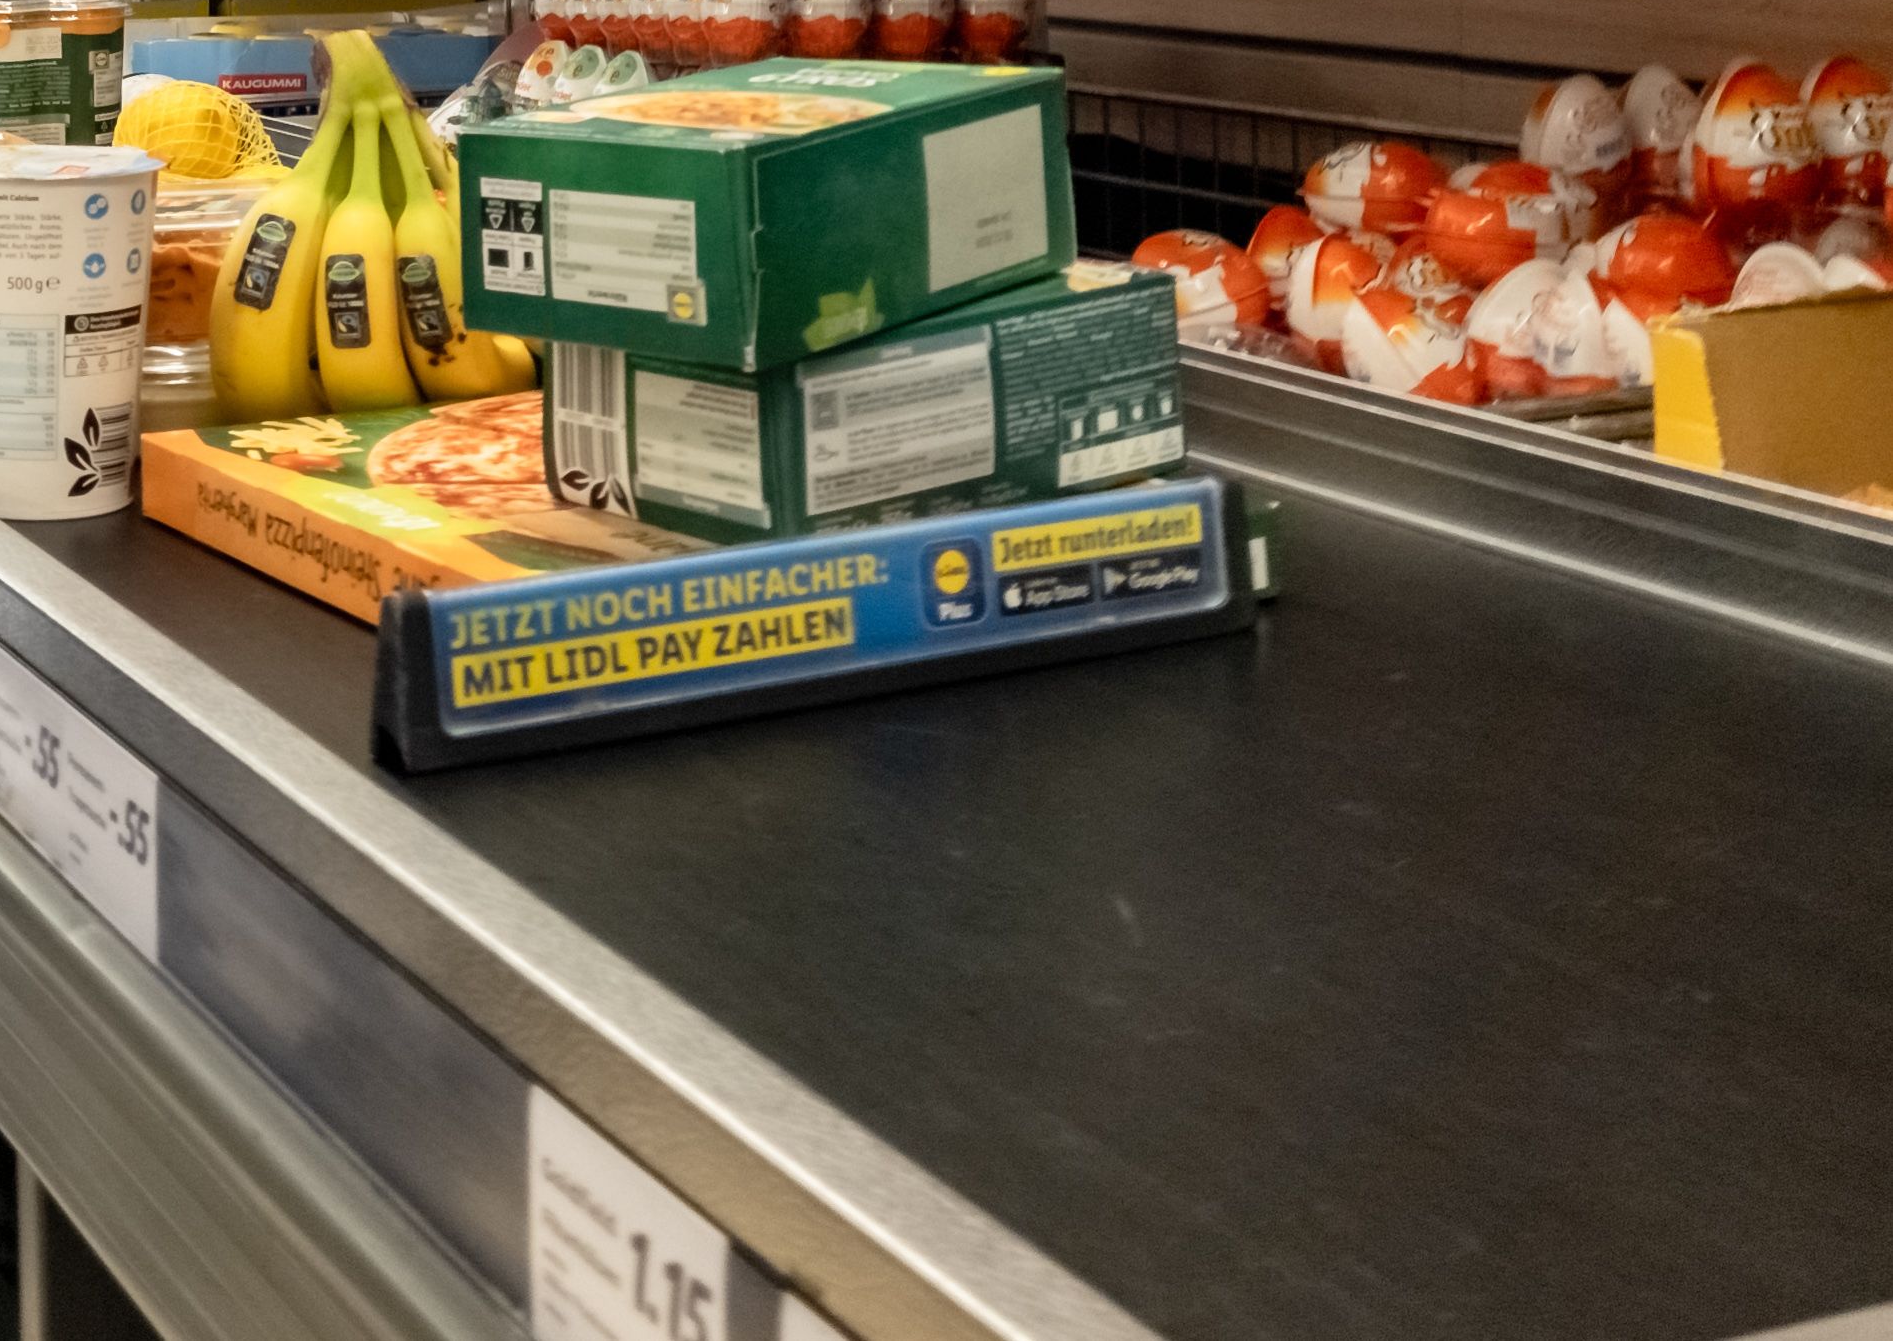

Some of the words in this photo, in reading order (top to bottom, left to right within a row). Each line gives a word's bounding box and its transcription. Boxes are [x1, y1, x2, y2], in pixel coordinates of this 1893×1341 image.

[221, 77, 304, 90] KAUGUMMI
[7, 276, 33, 291] 500
[35, 279, 44, 294] g
[998, 531, 1053, 565] Jetzt
[1059, 509, 1193, 555] runterladen!
[450, 600, 554, 649] JETZT
[566, 585, 672, 631] NOCH
[683, 554, 890, 613] EINFACHER:
[461, 655, 535, 698] MIT
[546, 640, 627, 686] LIDL
[639, 627, 704, 670] PAY
[713, 606, 848, 658] ZAHLEN
[109, 799, 150, 866] -.55
